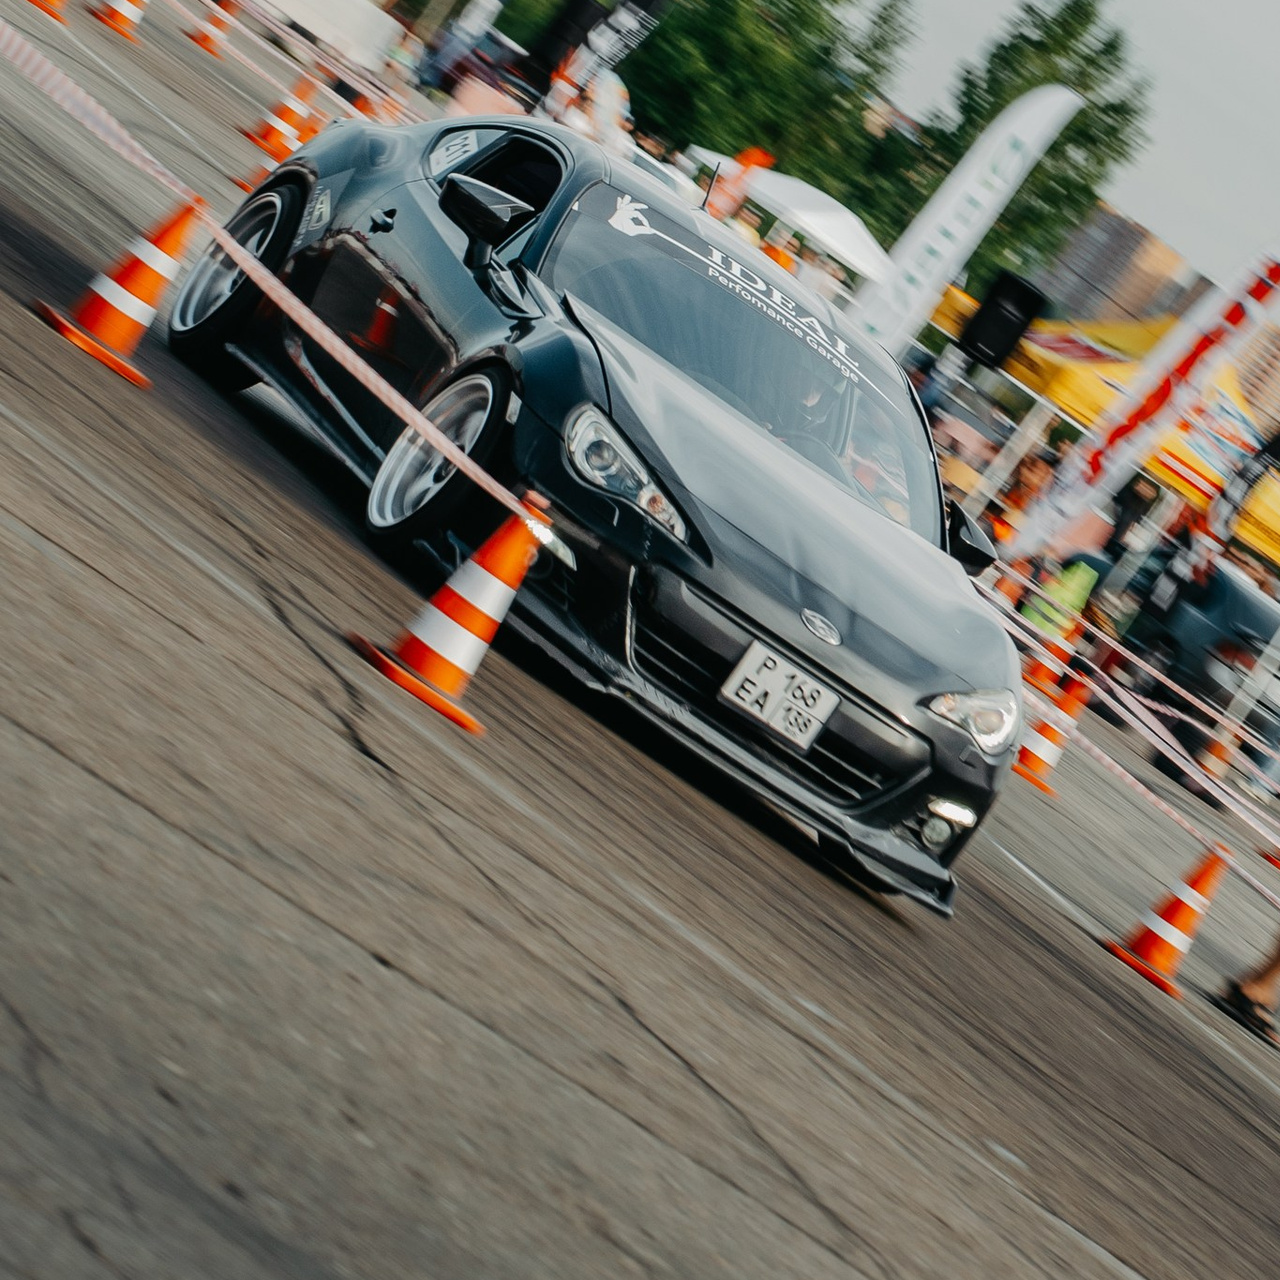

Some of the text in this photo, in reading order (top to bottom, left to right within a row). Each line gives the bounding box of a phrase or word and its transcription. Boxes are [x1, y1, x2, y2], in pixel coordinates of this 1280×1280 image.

[708, 245, 860, 368] IDEAL
[708, 268, 860, 383] Perfomance Garage
